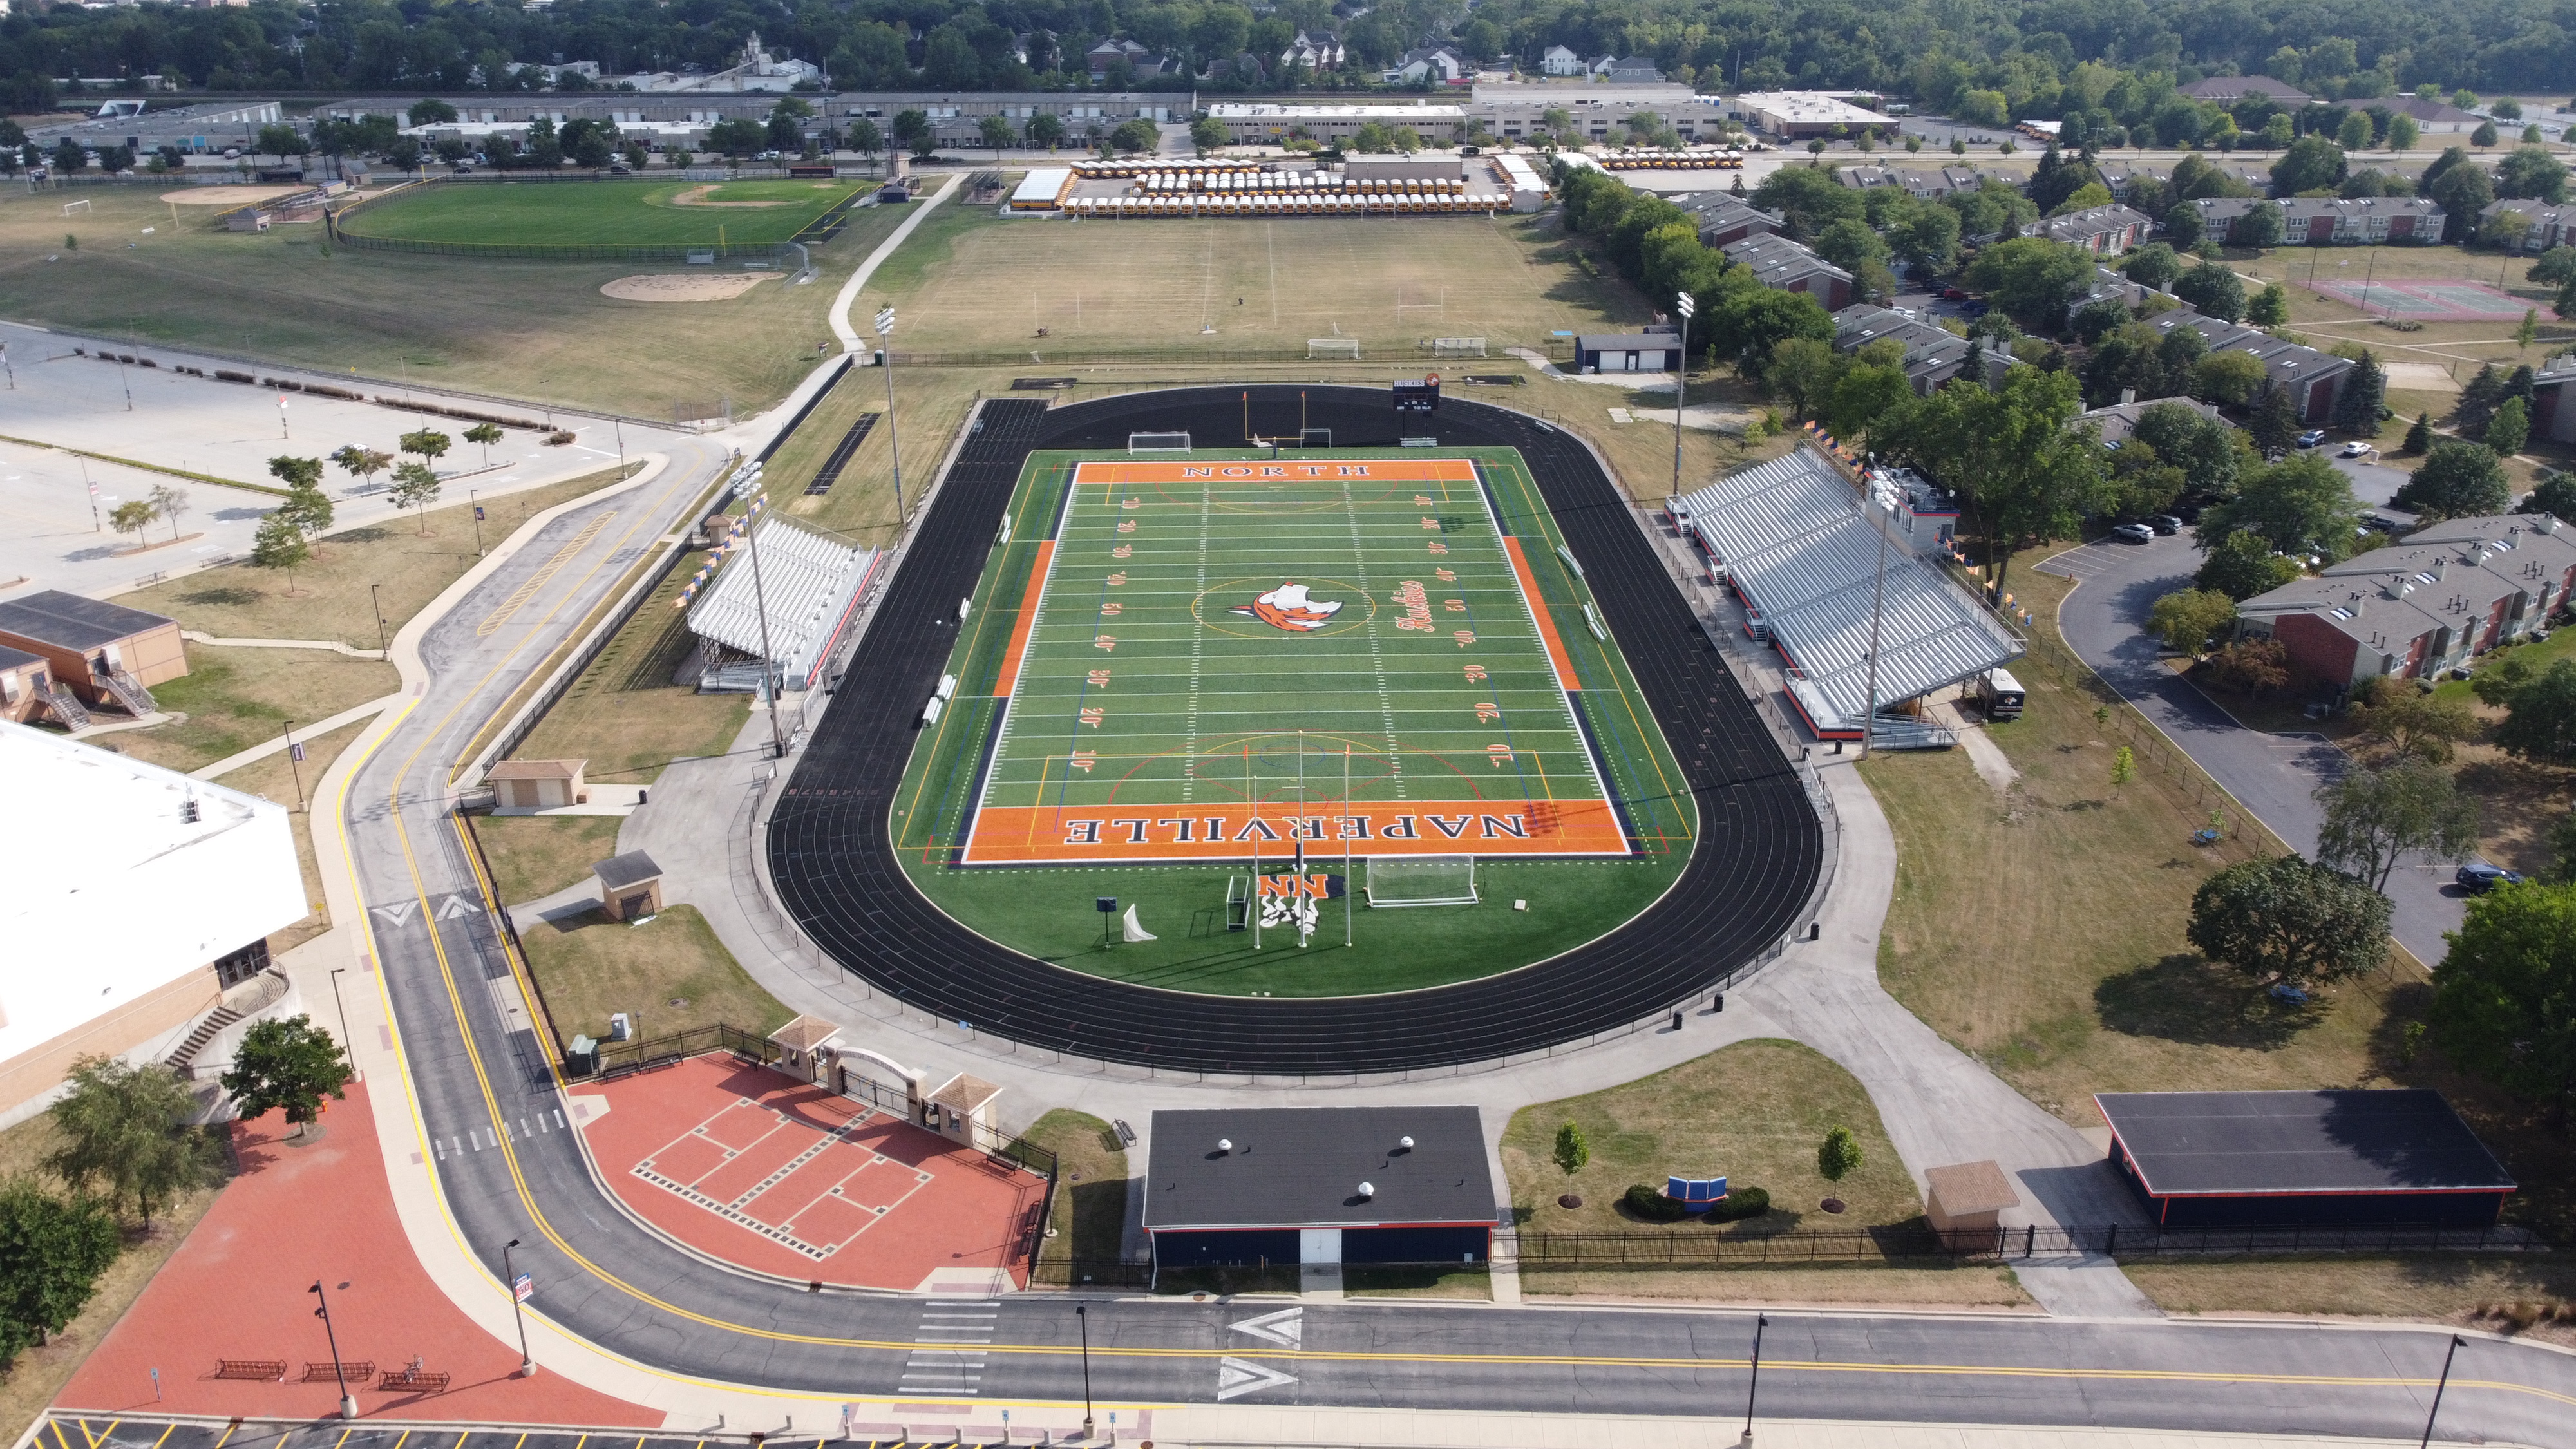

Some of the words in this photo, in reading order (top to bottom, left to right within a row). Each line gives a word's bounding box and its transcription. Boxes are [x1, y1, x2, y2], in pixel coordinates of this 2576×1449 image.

[1182, 466, 1370, 477] NORTH
[1101, 603, 1122, 615] 50
[1390, 580, 1435, 633] Huskies
[1444, 599, 1466, 611] 50
[1094, 634, 1117, 648] 40
[1453, 630, 1476, 643] 40
[1087, 670, 1111, 684] 30
[1463, 665, 1487, 679] 30
[1079, 708, 1104, 723] 20
[1474, 703, 1499, 718] 20
[1070, 750, 1097, 767] 10
[1486, 744, 1513, 762] 10
[1064, 814, 1530, 844] NAPERVILLE
[1258, 874, 1329, 899] NN
[868, 1056, 879, 1065] THE
[880, 1062, 907, 1081] HUSKIES
